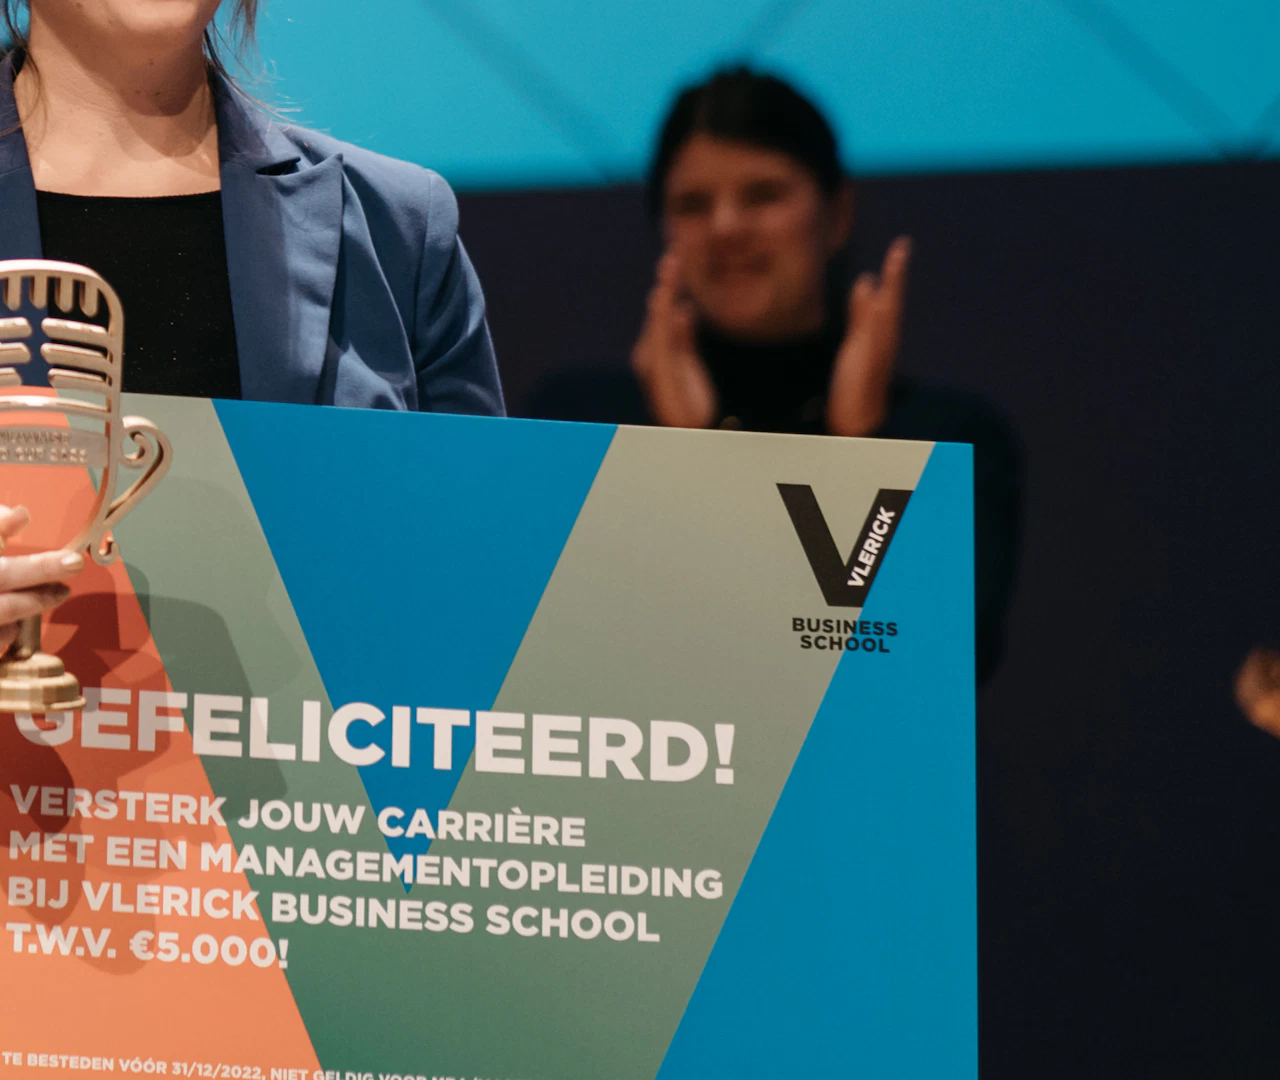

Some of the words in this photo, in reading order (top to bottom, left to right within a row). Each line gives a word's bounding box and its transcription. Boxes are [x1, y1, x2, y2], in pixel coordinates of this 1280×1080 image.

[847, 506, 896, 587] VLERICK
[792, 617, 898, 637] BUSINESS
[800, 635, 890, 653] SCHOOL
[14, 686, 735, 785] GEFELICITEERD!
[10, 784, 227, 827] VERSTERK
[238, 799, 366, 835] JOUW
[377, 806, 586, 848] CARRIÈRE
[8, 830, 94, 864] MET
[106, 836, 187, 870] EEN
[200, 842, 723, 900] MANAGEMENTOPLEIDING
[8, 876, 69, 910] BIJ
[81, 880, 260, 920] VLERICK
[272, 892, 474, 933] BUSINESS
[485, 905, 660, 943] SCHOOL
[6, 922, 116, 958] T.W.V.
[129, 930, 289, 969] €5.000!
[1, 1051, 22, 1066] TE
[27, 1053, 114, 1071] BESTEDEN
[119, 1057, 167, 1075] VÓÓR
[172, 1060, 266, 1080] 31/12/2022,
[270, 1068, 309, 1080] NIET
